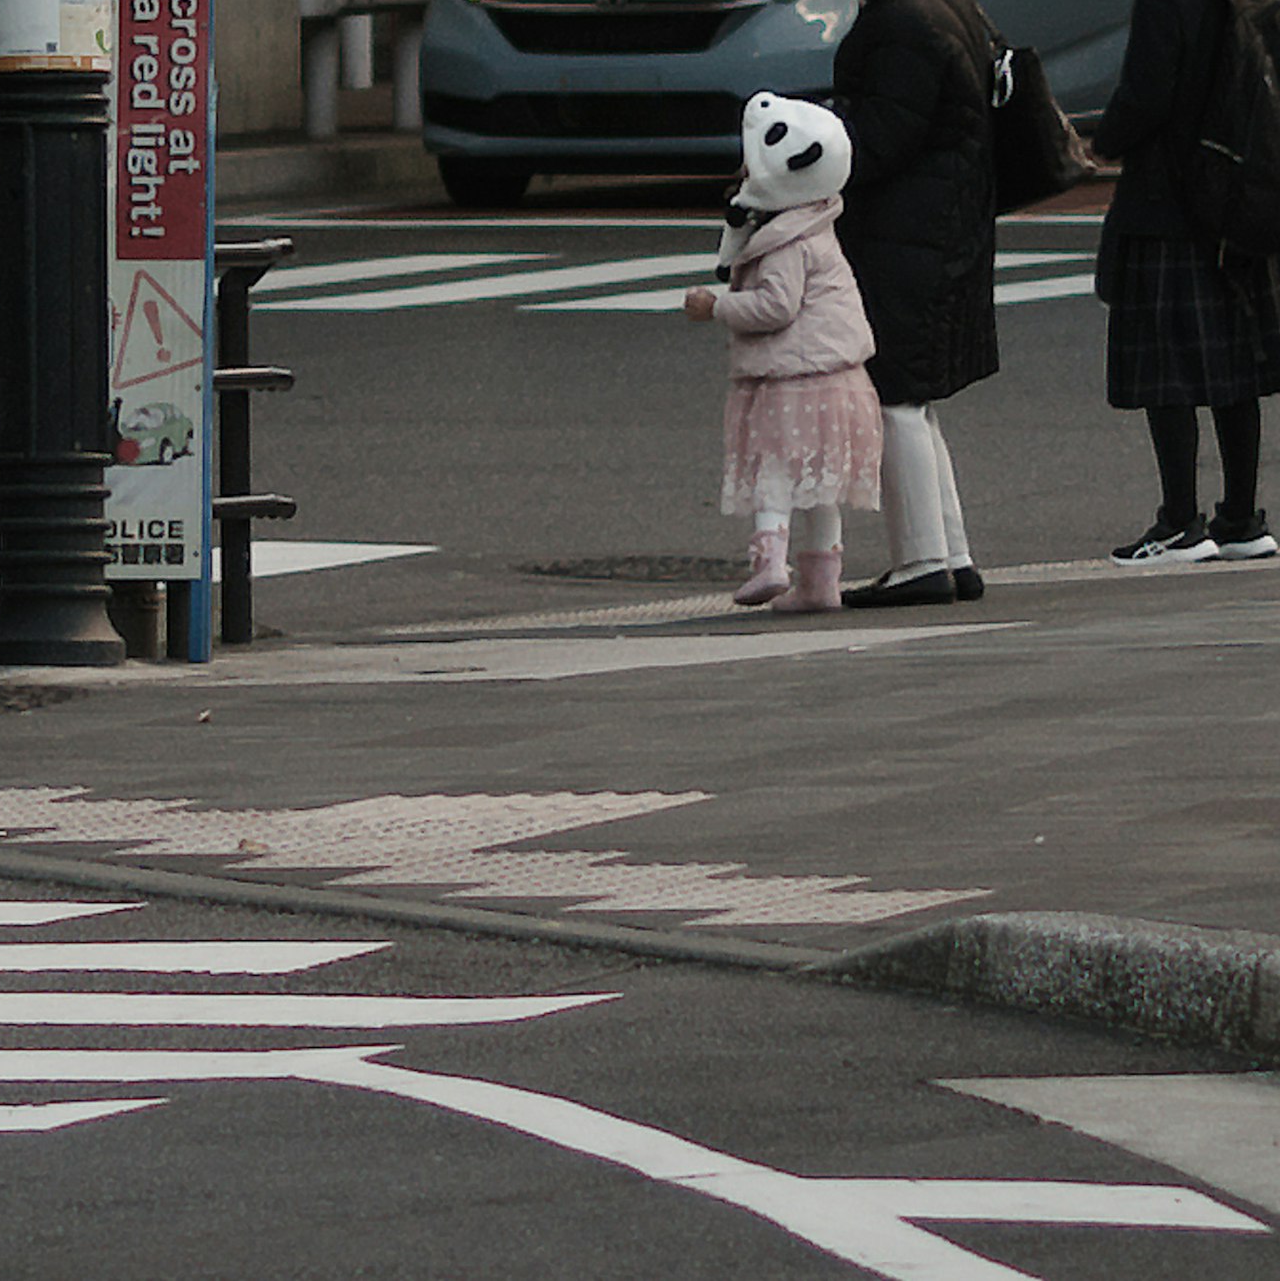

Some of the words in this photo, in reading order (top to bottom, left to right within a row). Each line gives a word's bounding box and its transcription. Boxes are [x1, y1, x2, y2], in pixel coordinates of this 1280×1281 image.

[130, 33, 166, 109] red
[126, 123, 167, 239] light!
[168, 130, 201, 175] at
